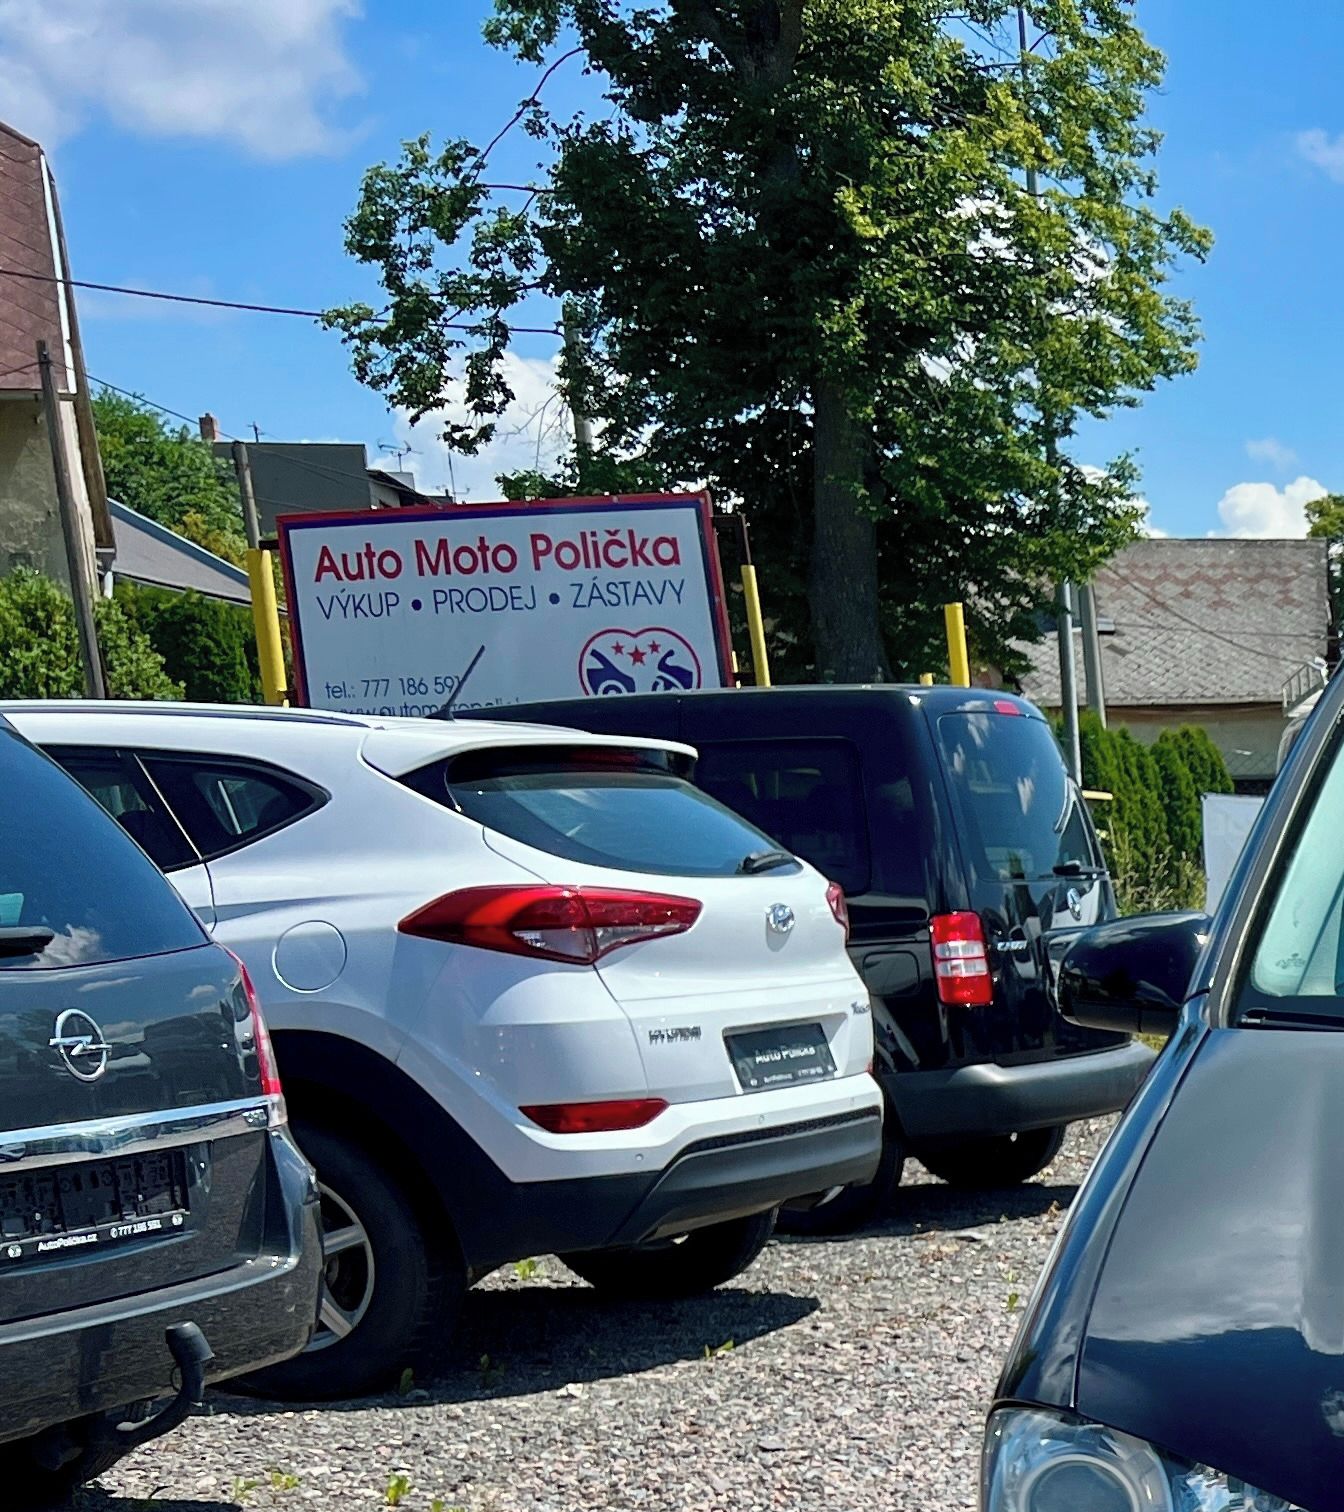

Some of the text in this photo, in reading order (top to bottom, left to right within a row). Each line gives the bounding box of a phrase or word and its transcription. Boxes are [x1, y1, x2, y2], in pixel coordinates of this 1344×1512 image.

[314, 528, 681, 583] Auto Moto Polička
[316, 576, 685, 620] VÝKUP PRODEJ ZÁSTAVY
[325, 680, 356, 699] tel.:
[361, 678, 390, 697] 777
[398, 677, 429, 696] 186
